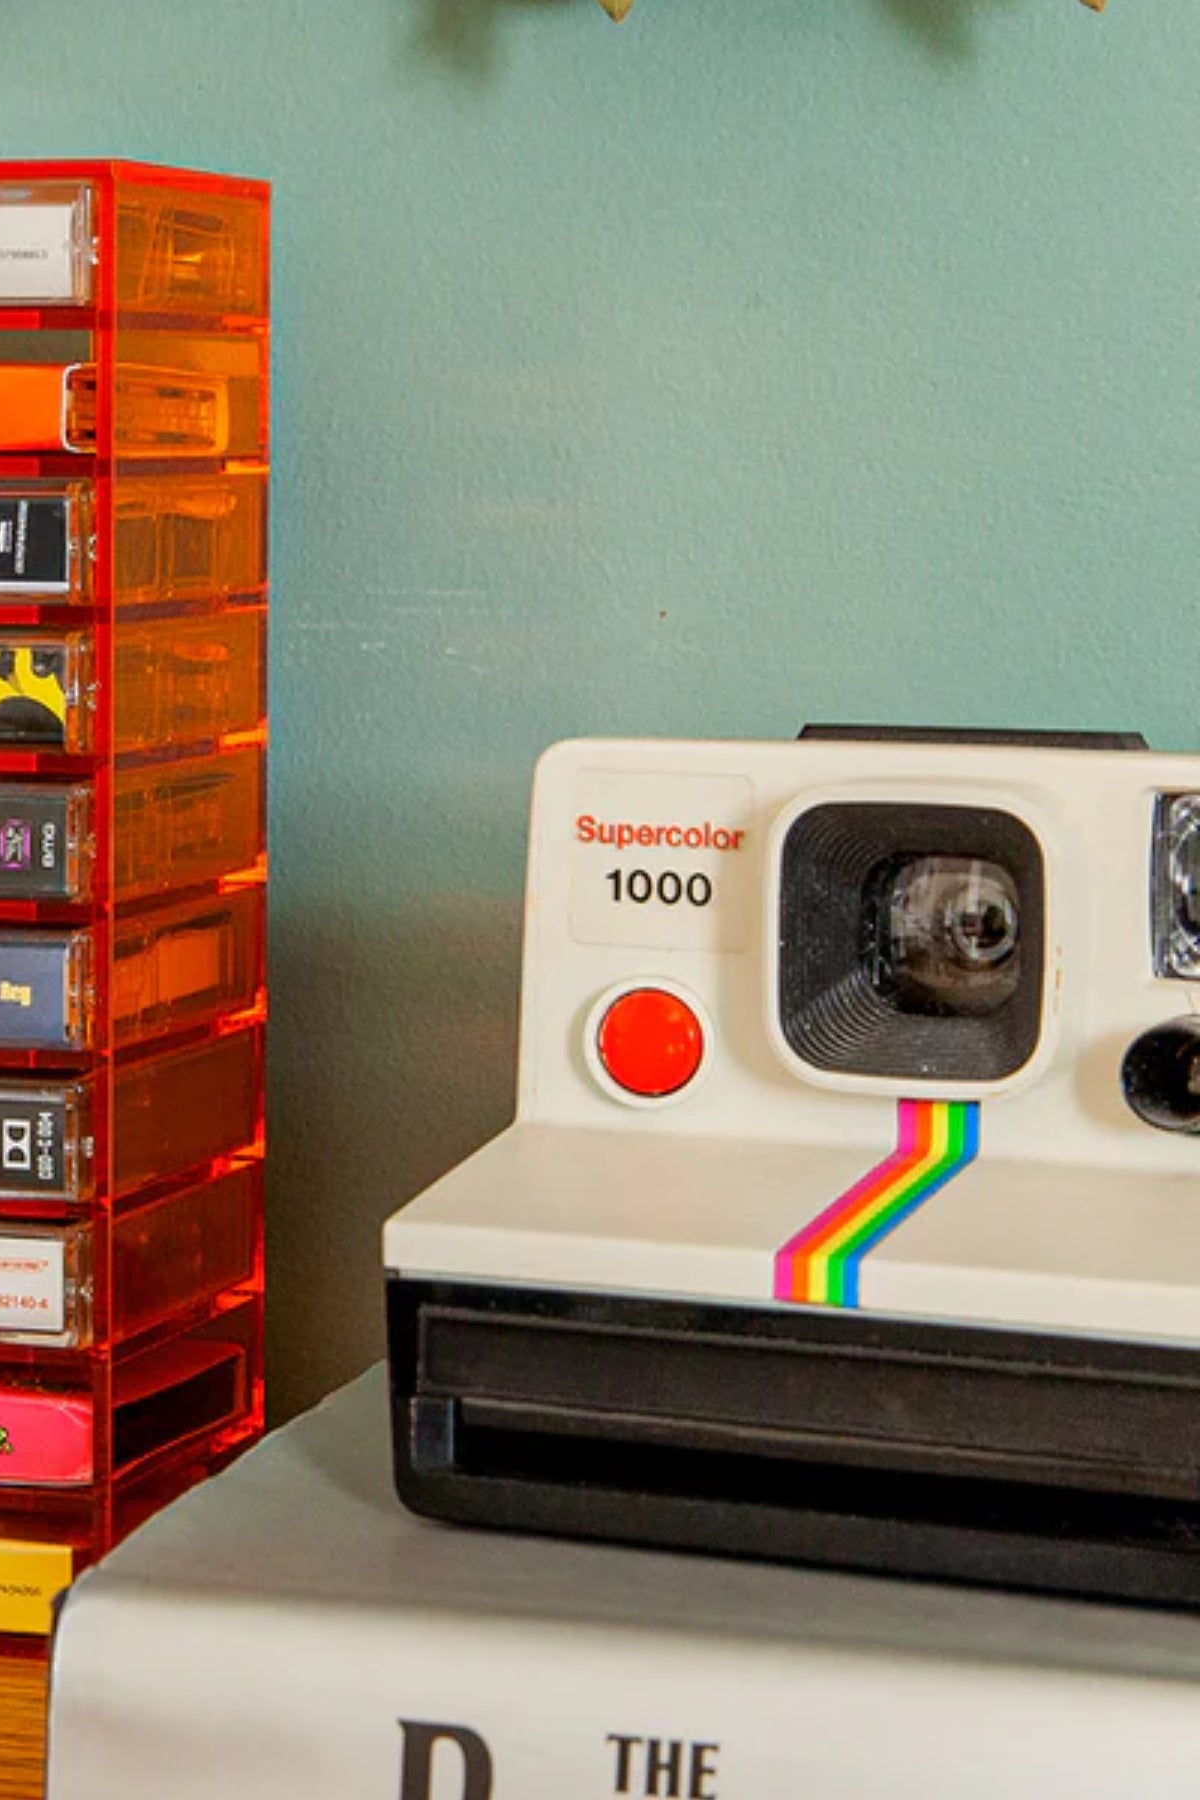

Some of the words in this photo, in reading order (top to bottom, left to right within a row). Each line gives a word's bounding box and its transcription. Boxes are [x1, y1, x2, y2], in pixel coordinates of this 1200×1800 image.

[575, 814, 747, 850] Supercolor
[605, 868, 712, 907] 1000
[0, 981, 32, 1006] Rey
[606, 1733, 719, 1800] THE
